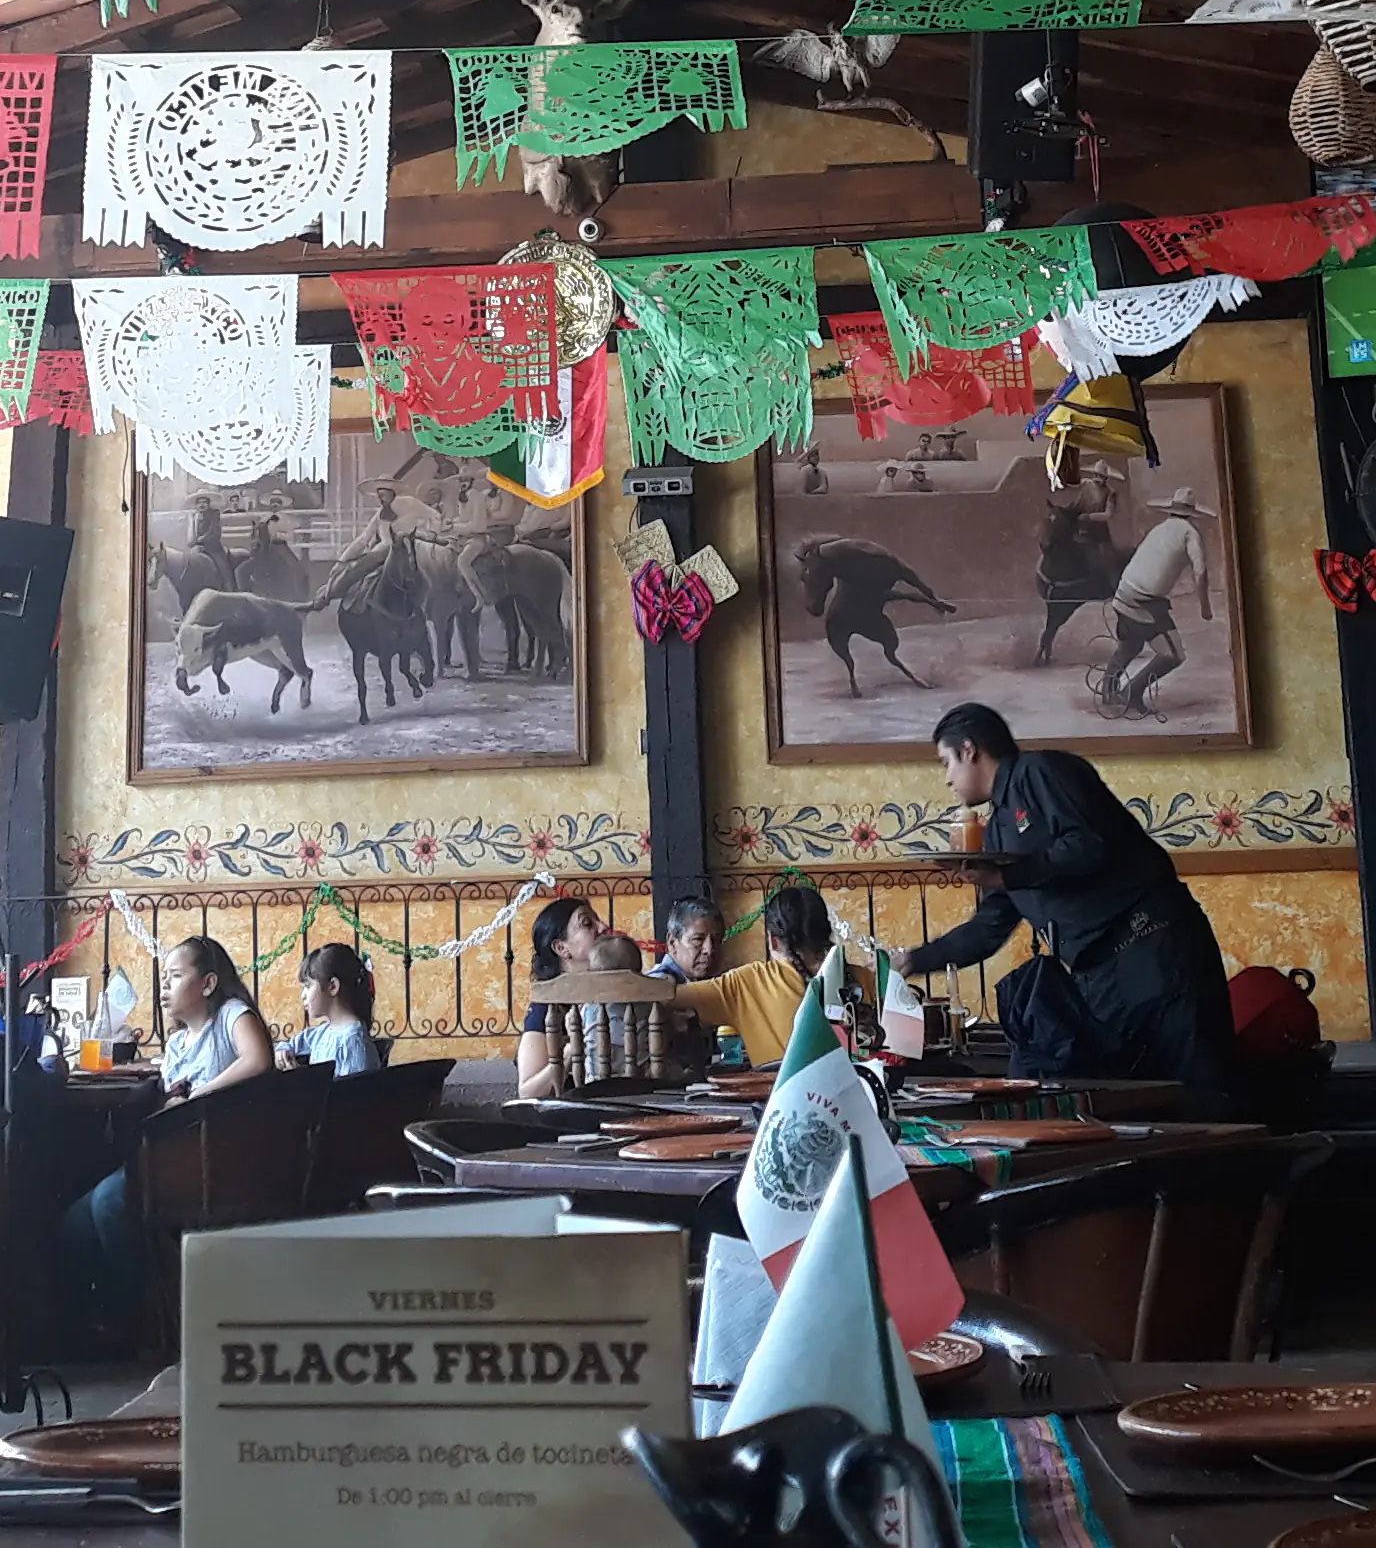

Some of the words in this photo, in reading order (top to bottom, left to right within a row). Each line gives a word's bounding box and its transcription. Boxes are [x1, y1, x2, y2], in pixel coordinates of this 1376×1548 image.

[807, 1091, 840, 1118] VIVA
[367, 1289, 497, 1312] VIERNES
[220, 1341, 418, 1385] BLACK
[432, 1341, 649, 1385] FRIDAY
[237, 1440, 410, 1469] Hamburguesa
[419, 1445, 488, 1469] negra
[496, 1440, 524, 1465] de
[337, 1487, 363, 1506] De
